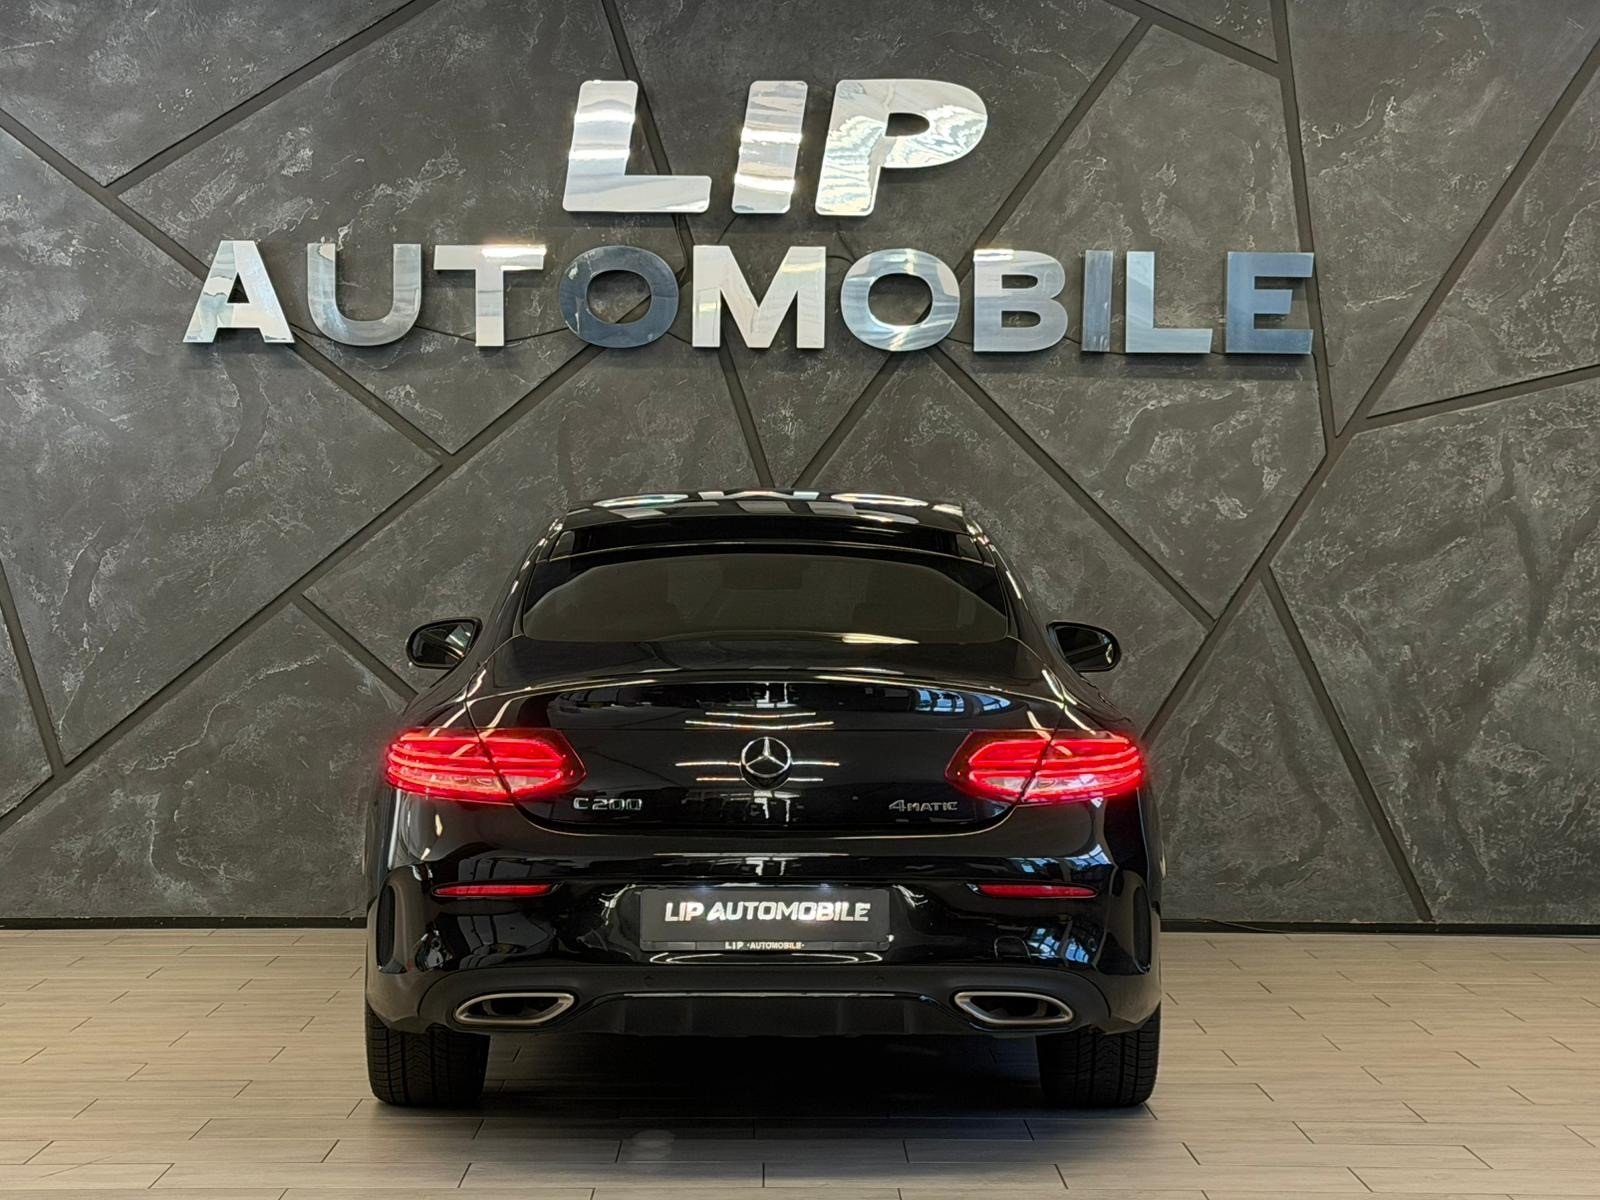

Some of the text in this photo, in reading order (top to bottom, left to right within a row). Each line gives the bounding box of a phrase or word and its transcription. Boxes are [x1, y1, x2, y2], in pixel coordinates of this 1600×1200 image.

[562, 78, 988, 216] LIP
[183, 240, 1315, 355] AUTOMOBILE
[664, 901, 871, 922] LIP AUTOMOBILE
[724, 941, 744, 950] LIP
